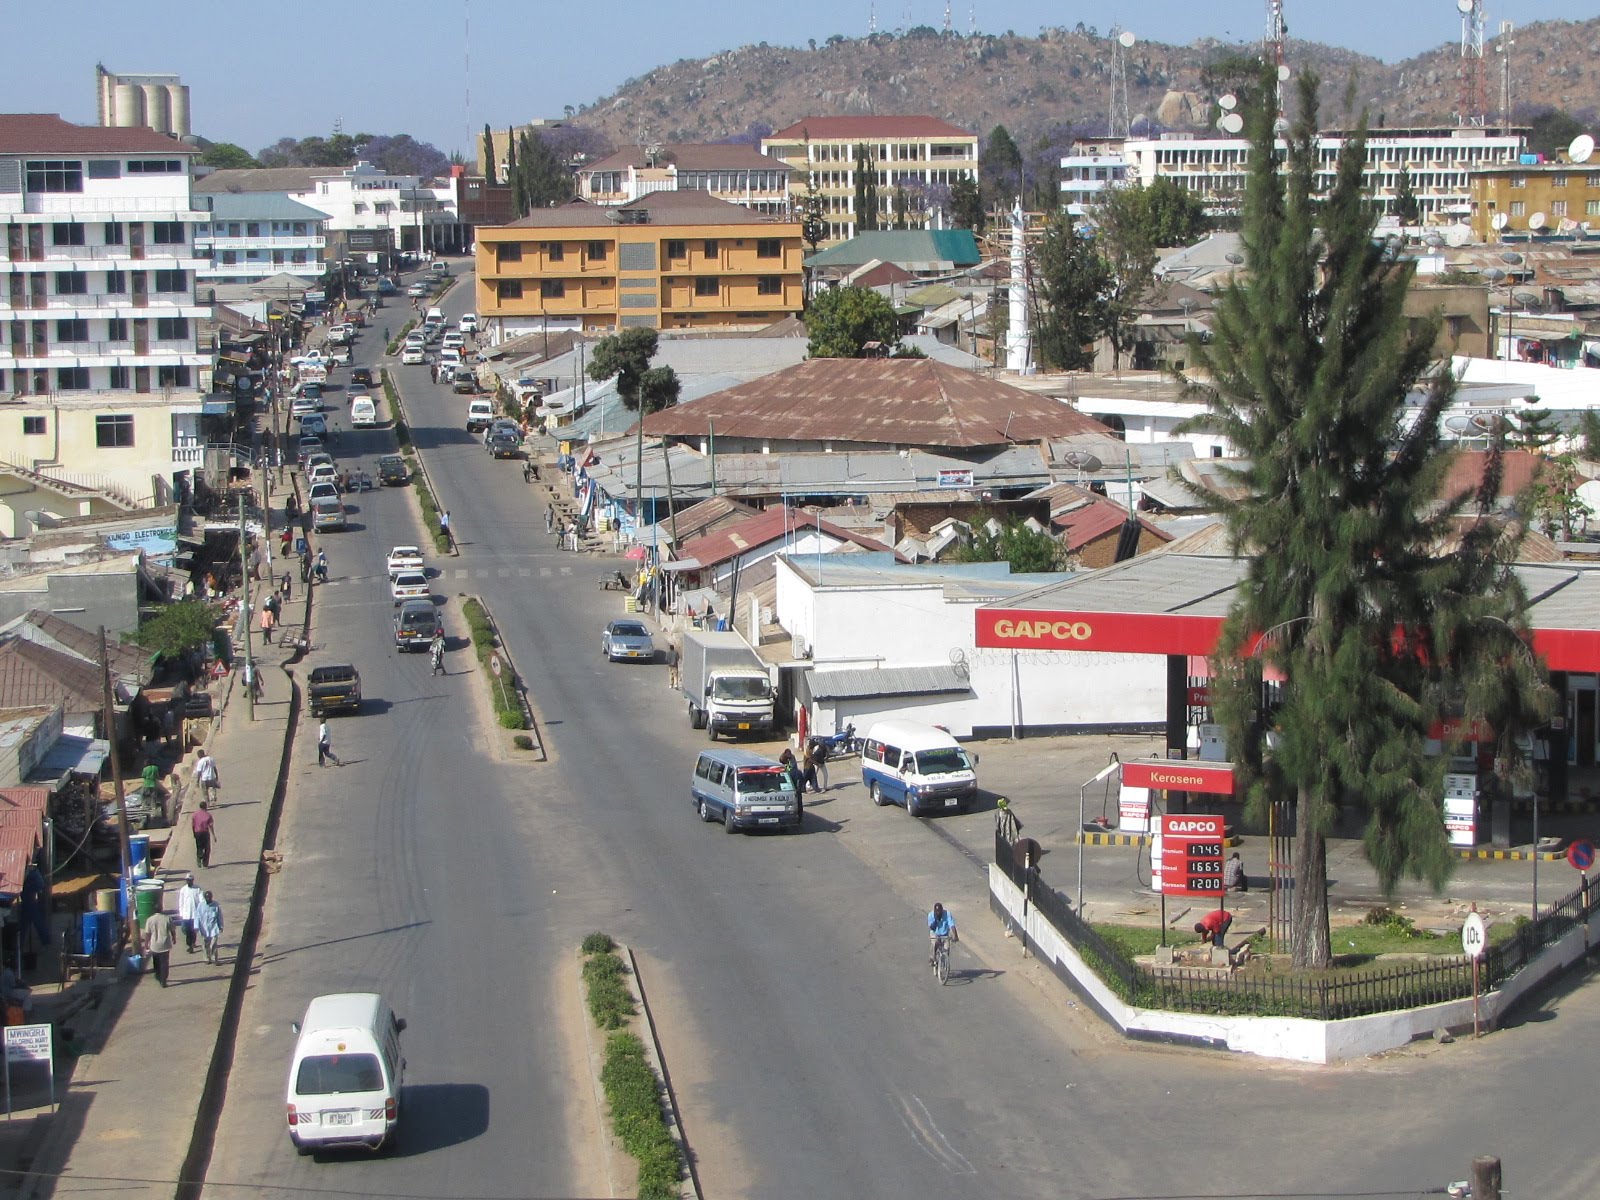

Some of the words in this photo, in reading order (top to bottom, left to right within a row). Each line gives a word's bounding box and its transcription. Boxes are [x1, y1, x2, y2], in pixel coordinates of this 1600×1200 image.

[994, 619, 1092, 640] GAPCO
[1150, 771, 1203, 785] Kerosene
[1168, 820, 1216, 832] GAPCO
[1192, 845, 1220, 855] 1745
[1192, 861, 1220, 872] 1665
[1192, 878, 1220, 889] 1200
[1466, 926, 1481, 945] 10t
